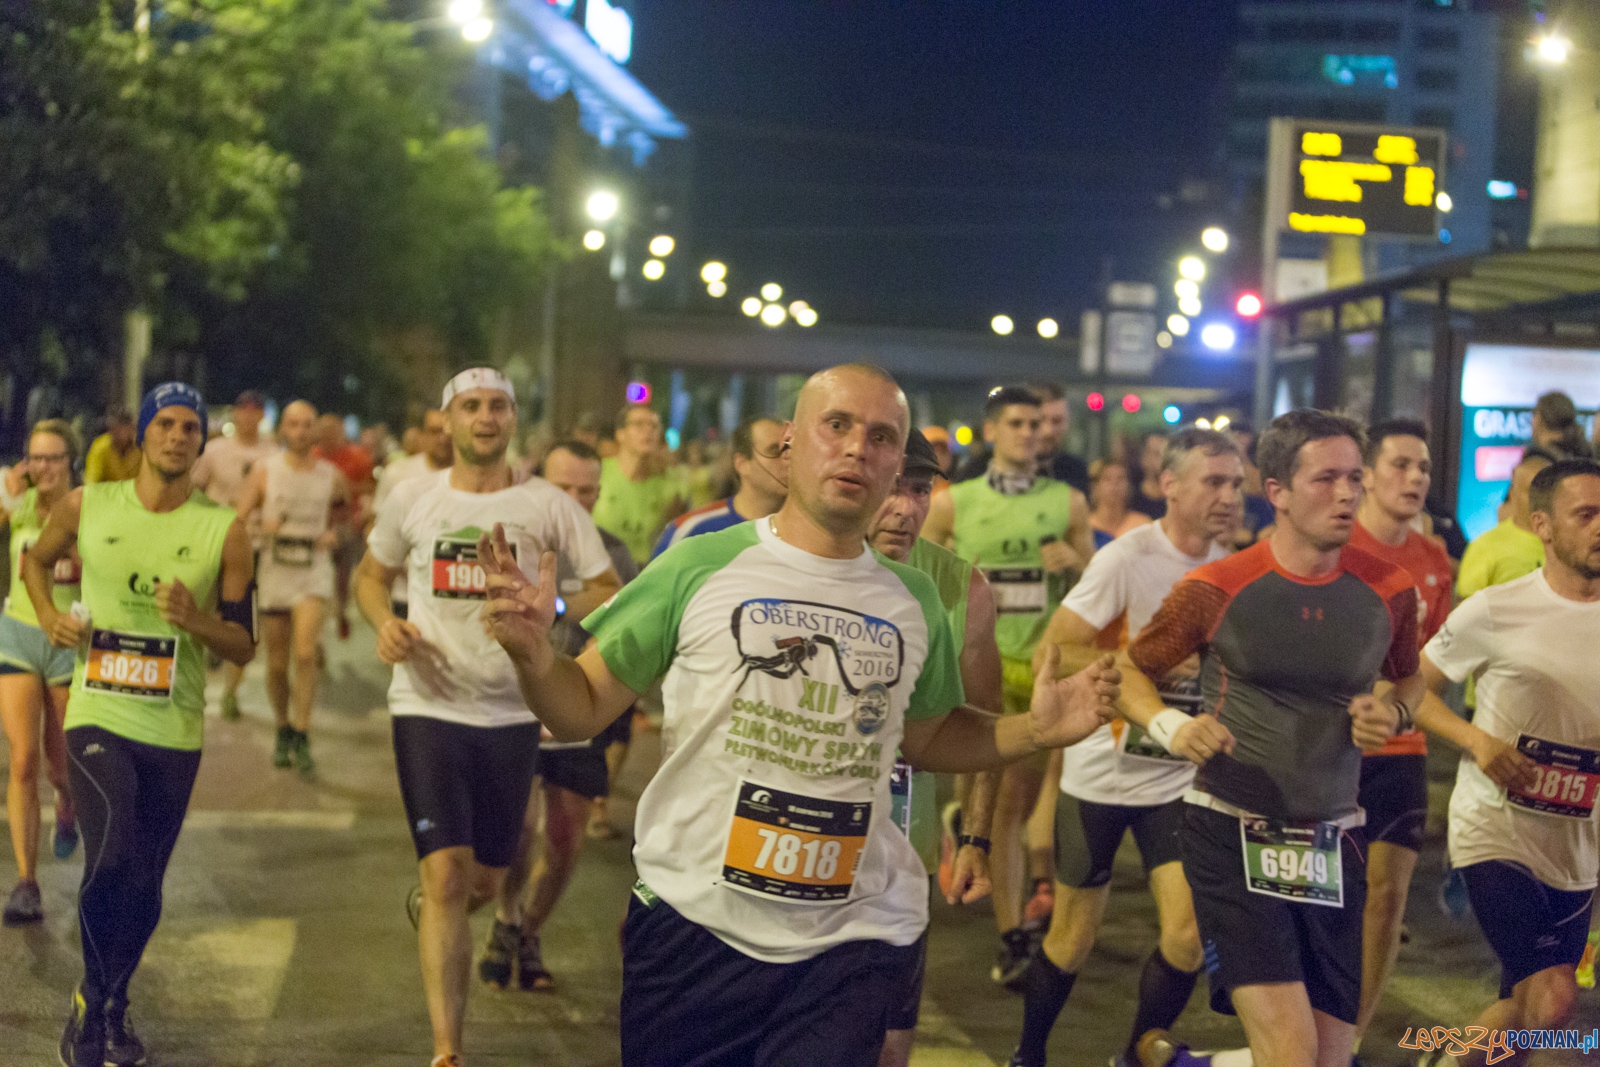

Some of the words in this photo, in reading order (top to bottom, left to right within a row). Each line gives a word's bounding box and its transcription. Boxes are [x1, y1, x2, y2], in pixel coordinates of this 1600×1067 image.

[446, 563, 487, 589] 190
[750, 608, 893, 649] OBERSTRONG
[100, 653, 159, 685] 5026
[853, 659, 894, 677] 2016
[798, 678, 839, 715] XII
[731, 697, 846, 736] OGÓLNOPOLSKI
[728, 715, 819, 757] ZIMOWY
[753, 828, 842, 880] 7818
[1261, 847, 1328, 884] 6949
